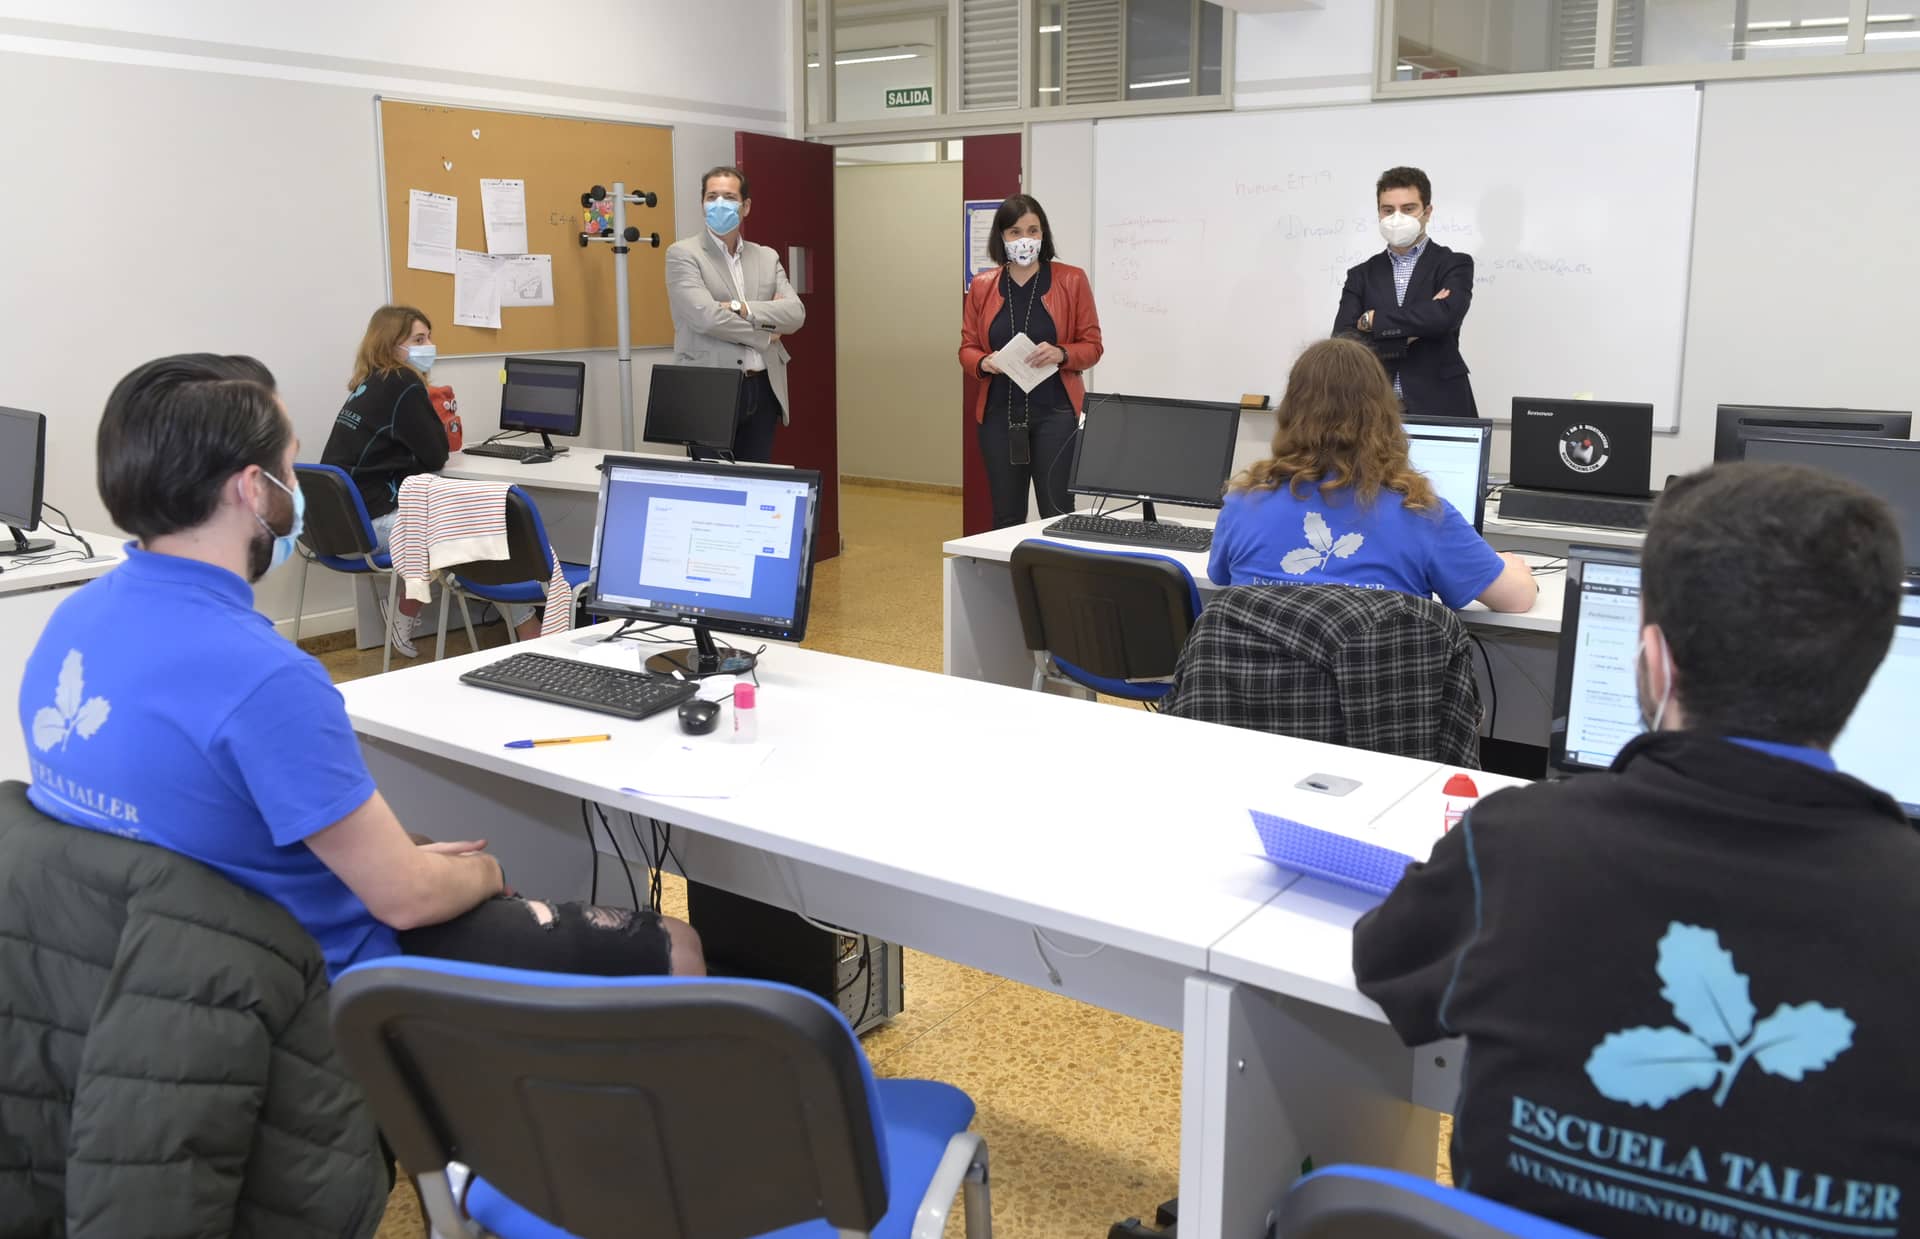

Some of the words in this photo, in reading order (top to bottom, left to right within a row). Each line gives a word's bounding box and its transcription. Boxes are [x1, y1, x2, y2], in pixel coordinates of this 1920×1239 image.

[888, 90, 930, 106] SALIDA
[1508, 1153, 1697, 1227] AYUNTAMIENTO
[1700, 1208, 1738, 1238] DE
[1512, 1096, 1708, 1183] ESCUELA
[1720, 1152, 1901, 1220] TALLER
